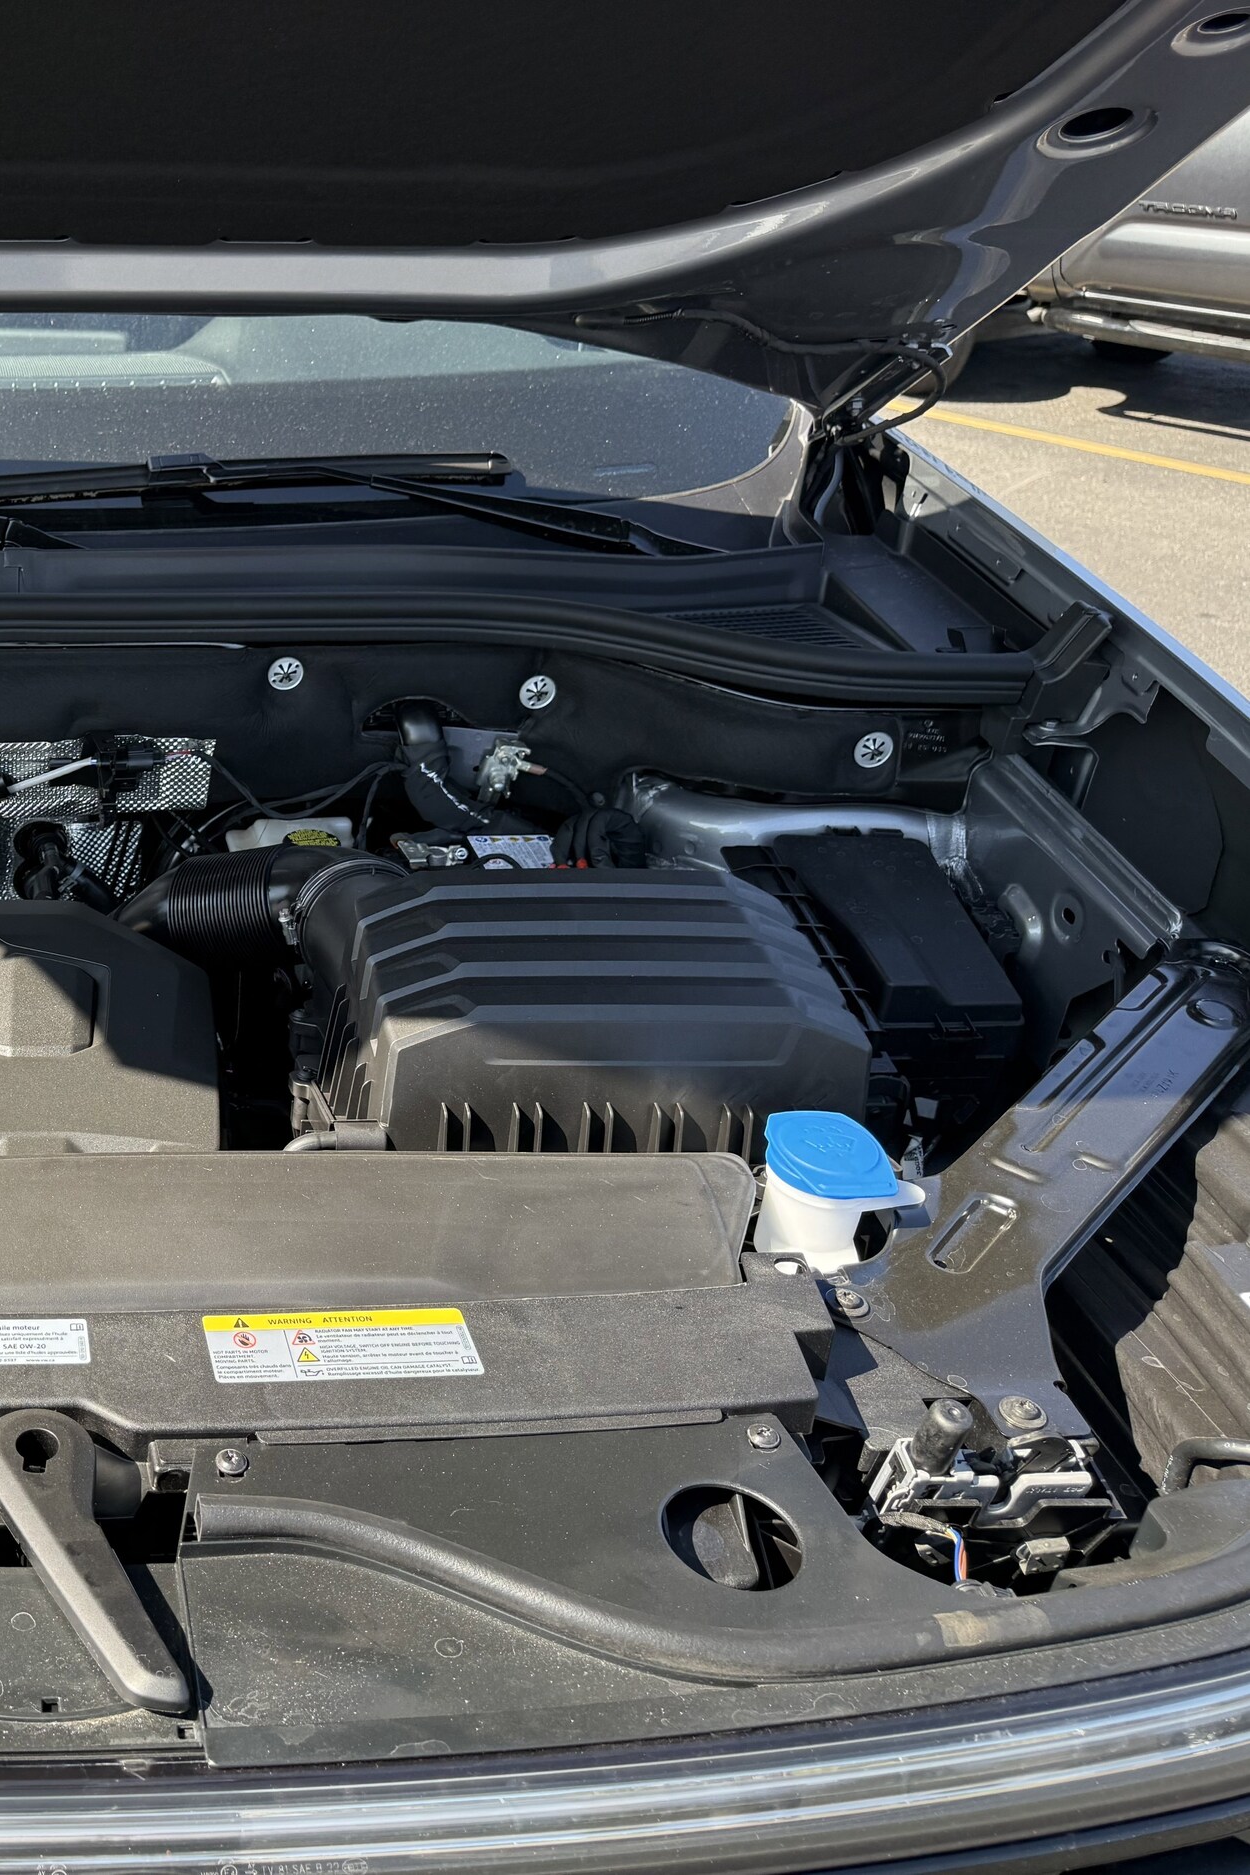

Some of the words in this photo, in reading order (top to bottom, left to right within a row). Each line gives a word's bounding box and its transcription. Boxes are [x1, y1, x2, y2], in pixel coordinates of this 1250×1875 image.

[1138, 199, 1238, 220] TACOMA
[268, 1317, 312, 1325] WARNING
[293, 1863, 312, 1873] SAE
